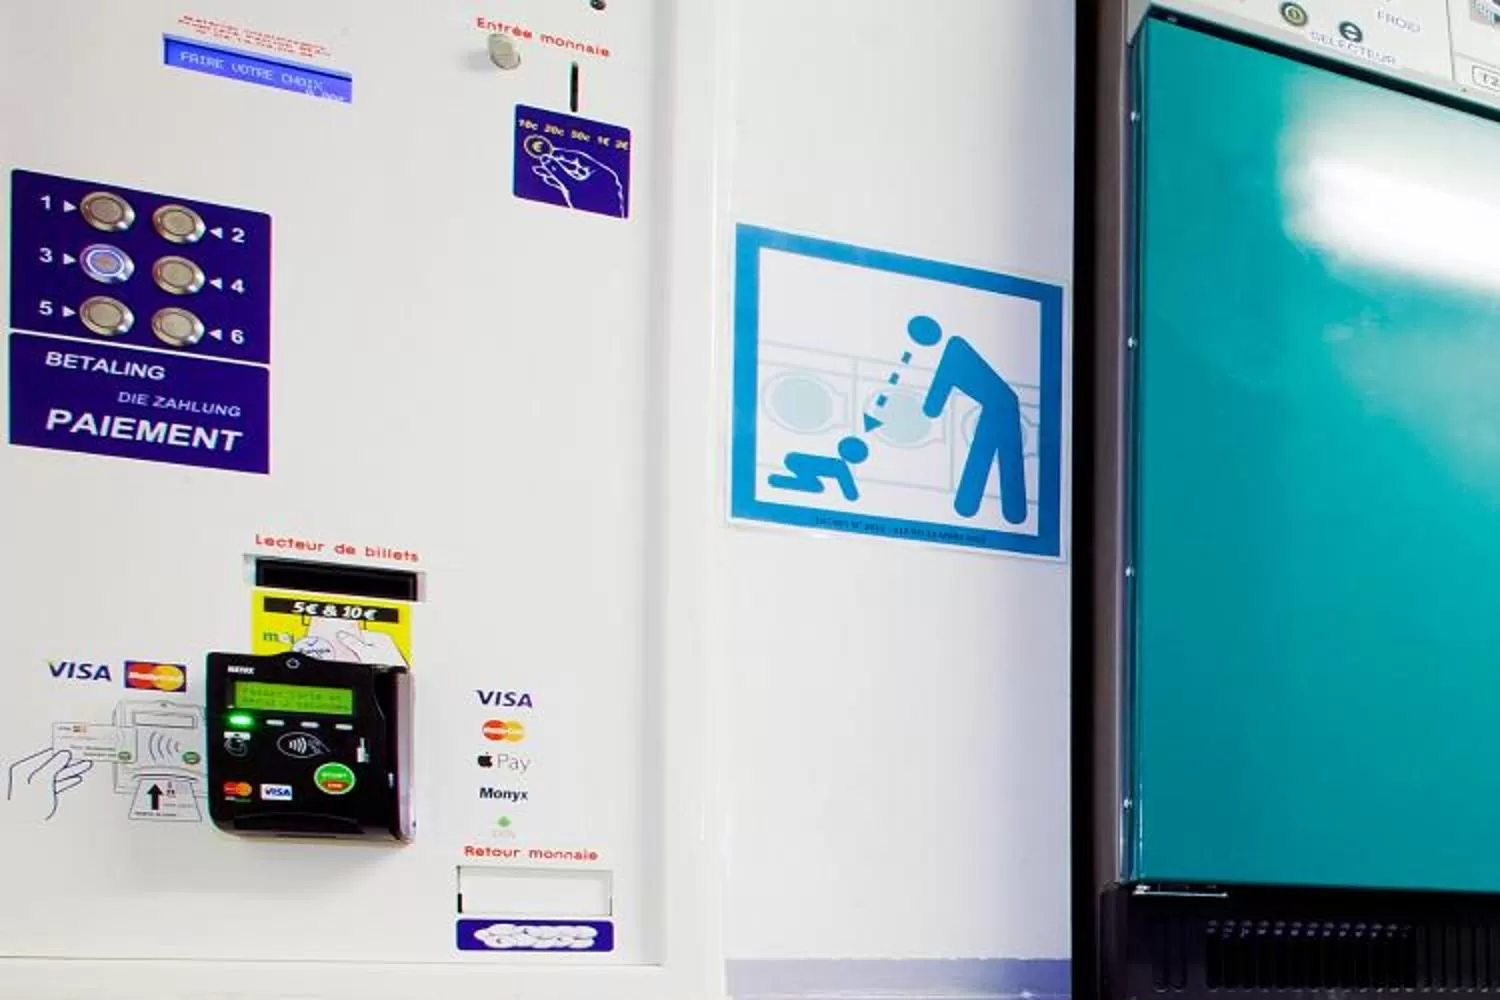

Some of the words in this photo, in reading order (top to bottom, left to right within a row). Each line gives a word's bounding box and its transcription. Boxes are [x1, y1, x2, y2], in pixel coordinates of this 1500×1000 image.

[540, 34, 610, 57] monnaie
[180, 51, 225, 70] FAIRE
[231, 63, 273, 81] VOTRE
[281, 73, 325, 91] CHOIX
[41, 195, 51, 209] 1
[231, 228, 245, 243] 2
[39, 248, 53, 263] 3
[231, 279, 245, 294] 4
[39, 301, 53, 316] 5
[231, 329, 245, 345] 6
[45, 351, 166, 381] BETALING
[117, 391, 149, 406] DIE
[152, 395, 241, 417] ZAHLUNG
[46, 409, 243, 452] PAIEMENT
[256, 534, 325, 551] Lecteur
[334, 543, 356, 555] de
[365, 546, 419, 562] billets
[293, 602, 319, 615] 5€
[322, 604, 338, 617] &
[48, 661, 112, 682] VISA
[476, 689, 533, 709] VISA
[497, 753, 531, 774] Pay
[265, 787, 291, 797] VISA
[479, 786, 528, 803] Monyx
[463, 845, 521, 858] Retour
[529, 848, 599, 861] monnaie
